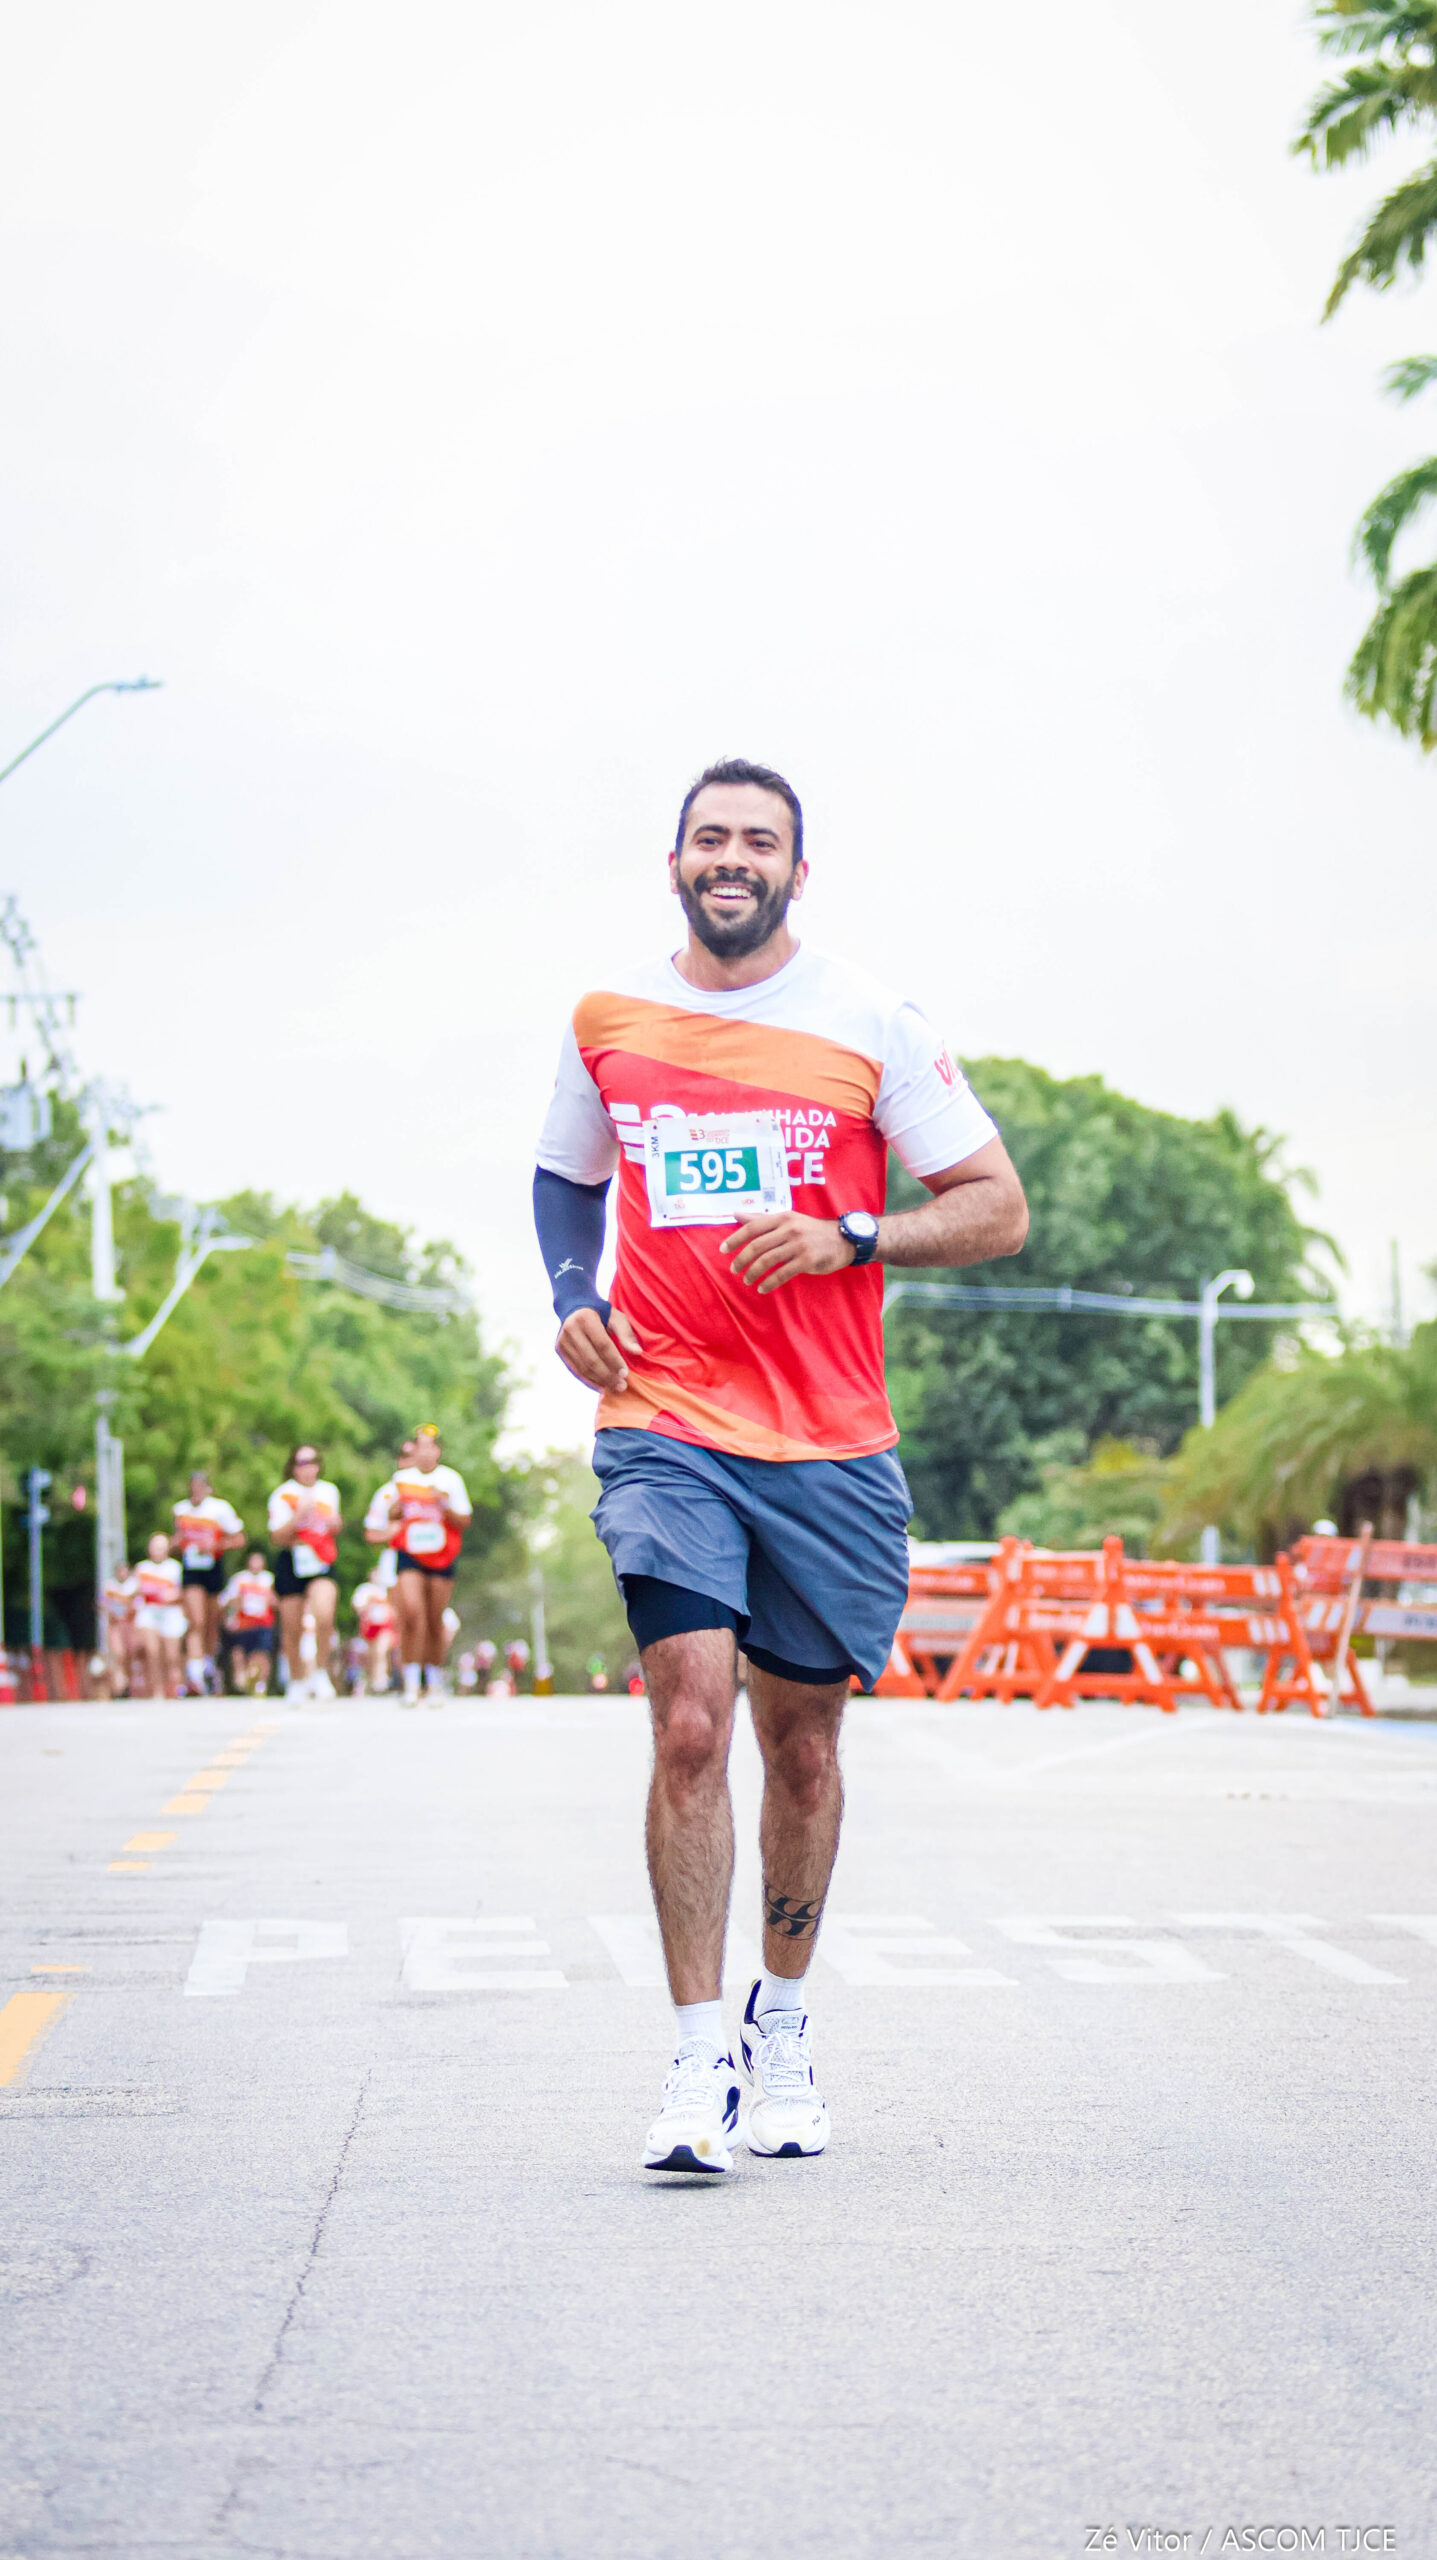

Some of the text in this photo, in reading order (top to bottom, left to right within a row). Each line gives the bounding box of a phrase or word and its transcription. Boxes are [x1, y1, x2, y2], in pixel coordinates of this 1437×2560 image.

[771, 1109, 837, 1127] HADA
[650, 1136, 660, 1158] 3KM
[785, 1127, 831, 1149] IDA
[680, 1149, 747, 1192] 595
[786, 1151, 826, 1186] CE
[183, 1912, 1437, 1997] PEEST
